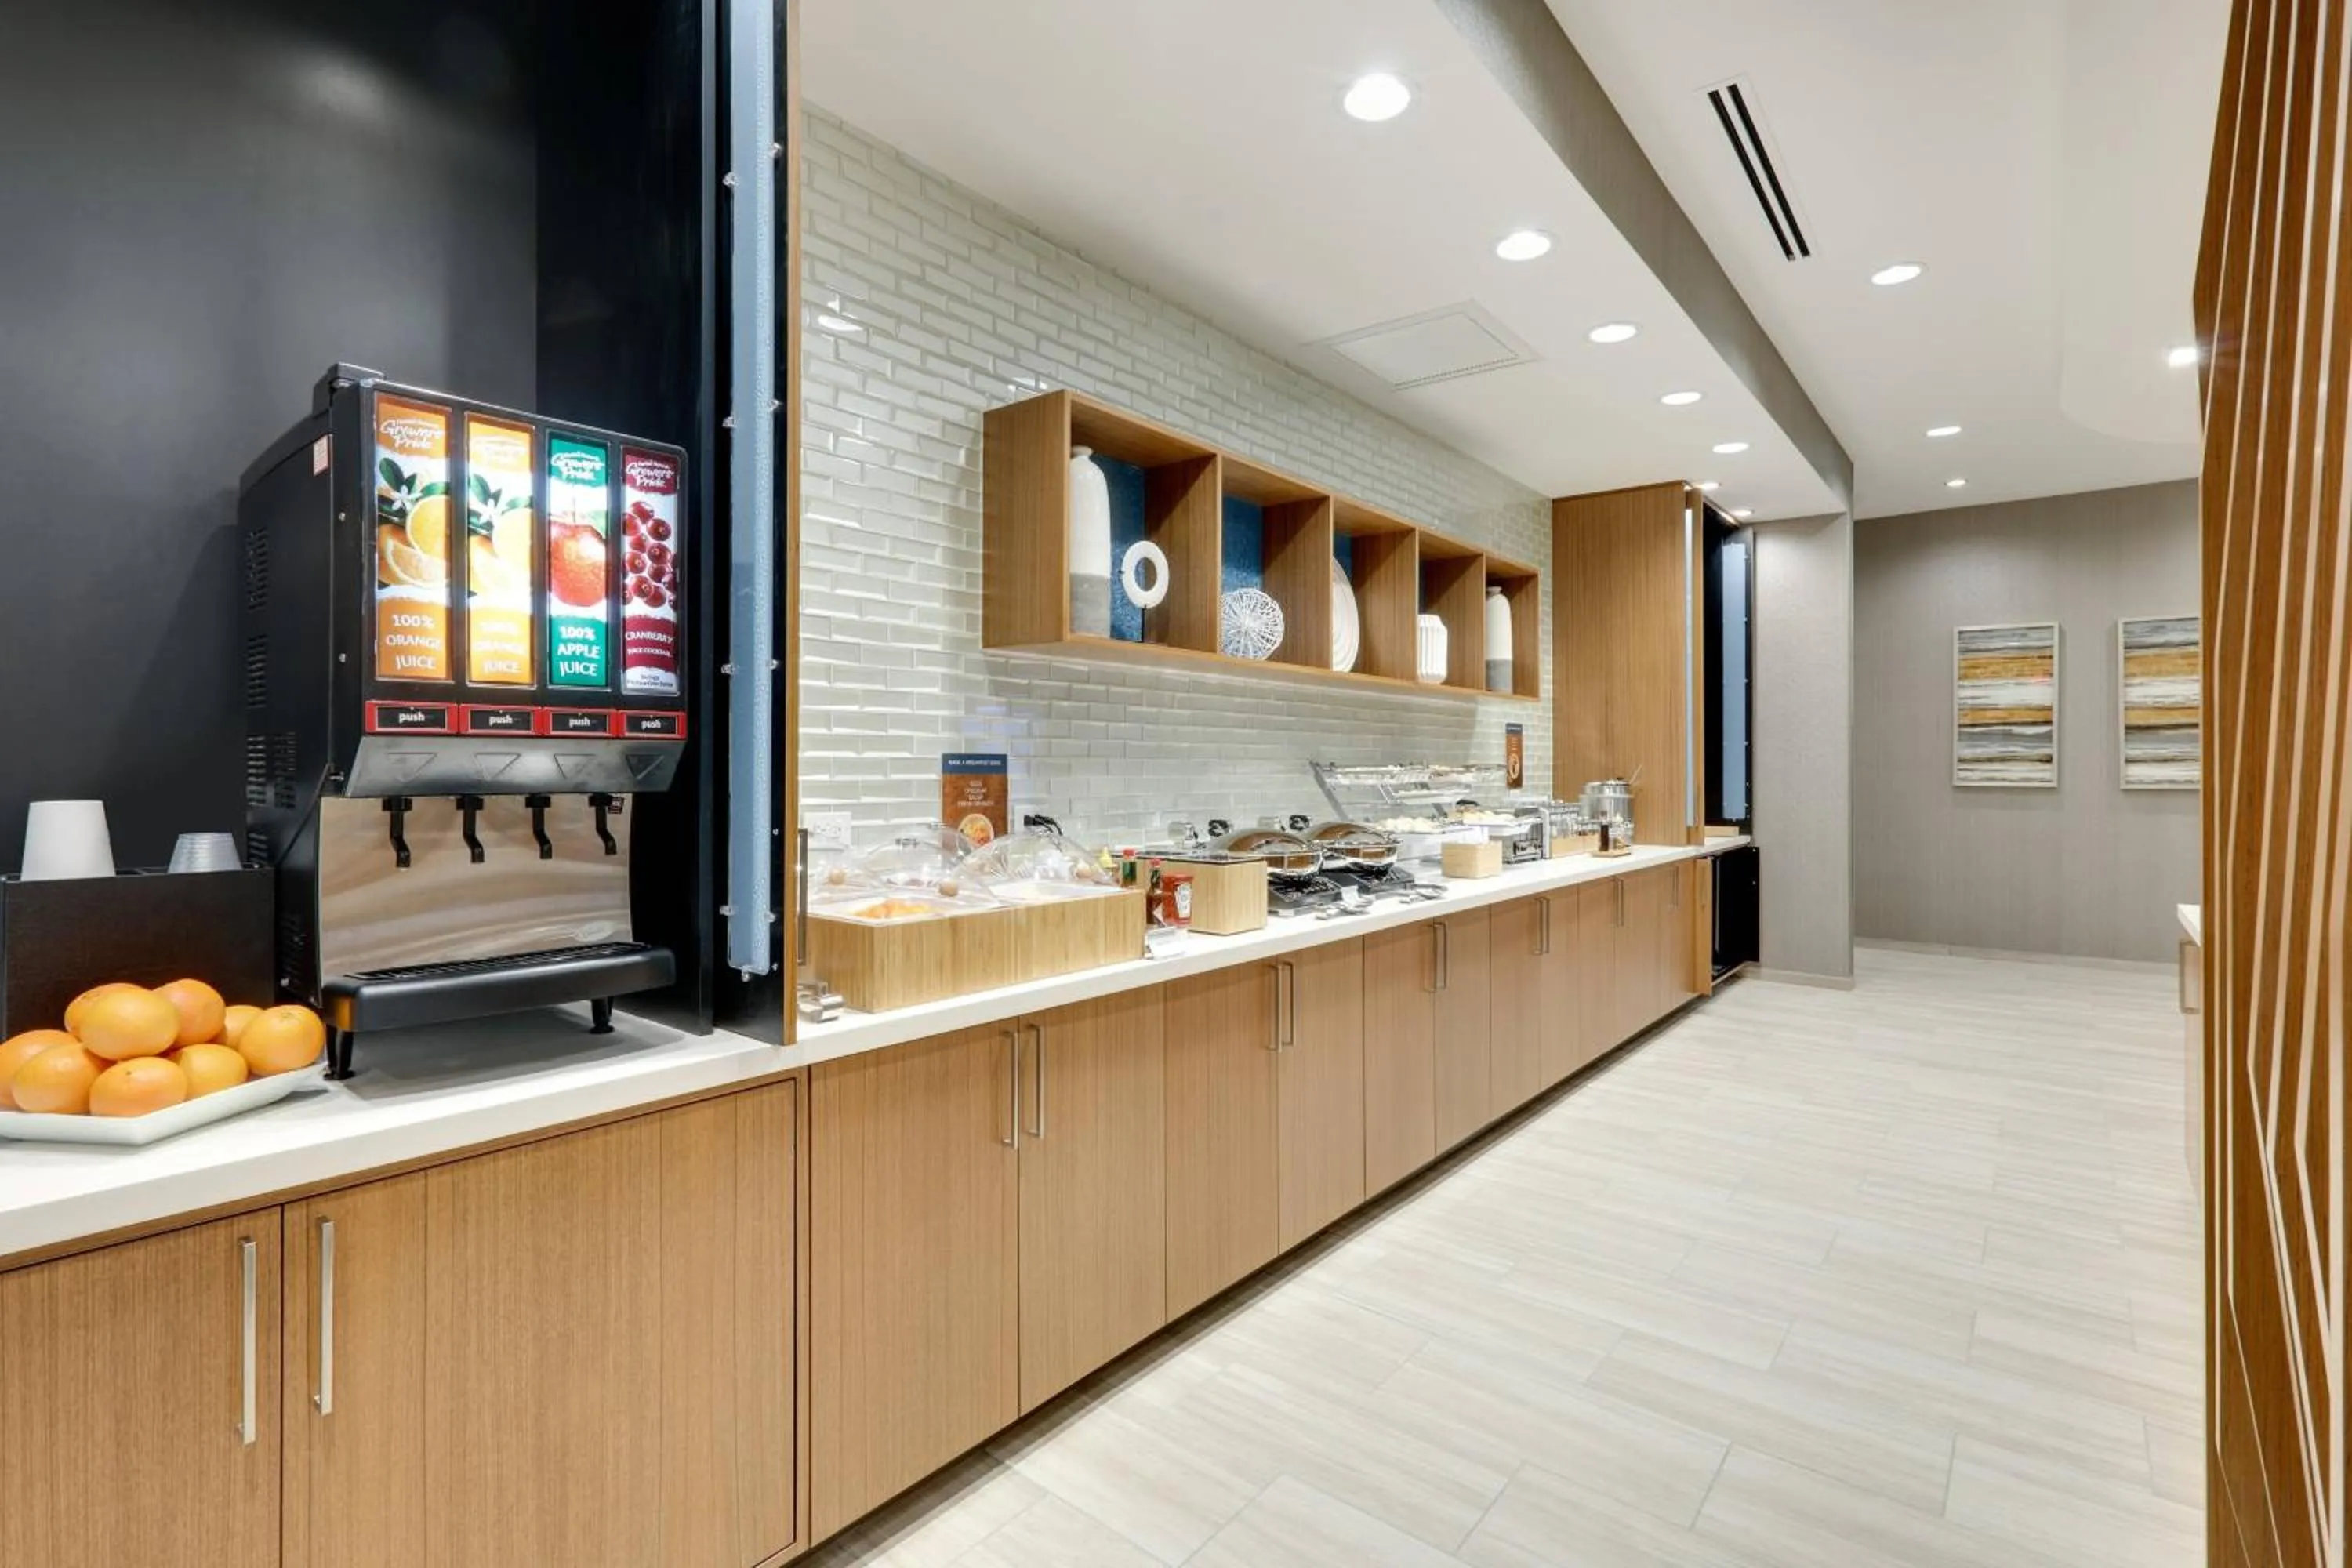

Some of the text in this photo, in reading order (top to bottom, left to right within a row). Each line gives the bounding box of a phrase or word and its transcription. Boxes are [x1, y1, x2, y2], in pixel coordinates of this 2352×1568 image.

[394, 437, 433, 450] Pride
[636, 475, 666, 488] Pride
[392, 614, 435, 629] 100%
[559, 626, 597, 641] 100%
[625, 630, 674, 644] CRANBERRY
[386, 633, 443, 652] ORANGE
[557, 643, 601, 659] APPLE
[396, 655, 436, 670] JUICE
[559, 661, 598, 677] JUICE
[399, 712, 425, 724] push
[488, 714, 514, 726] push
[568, 717, 590, 728] push
[641, 719, 662, 730] push
